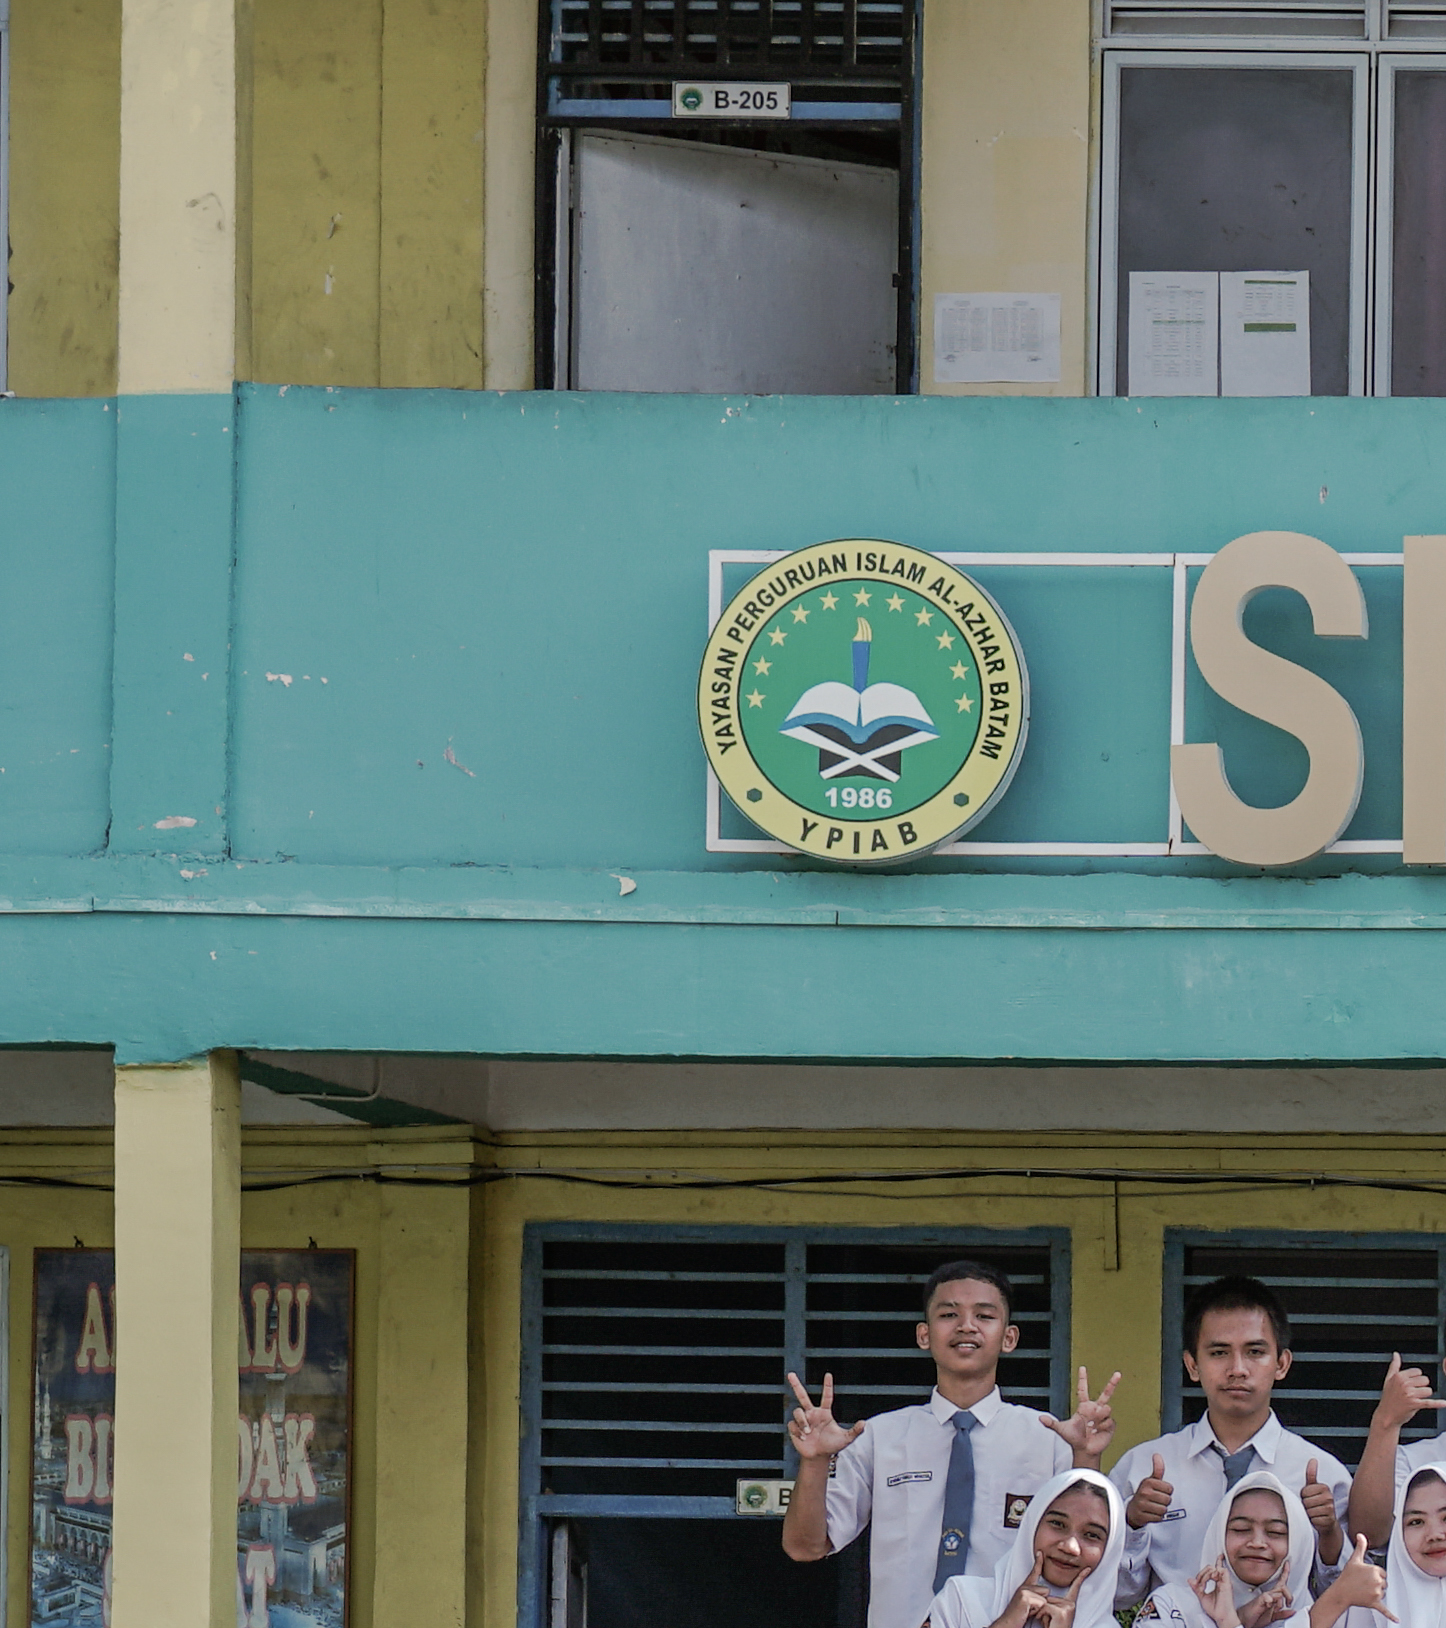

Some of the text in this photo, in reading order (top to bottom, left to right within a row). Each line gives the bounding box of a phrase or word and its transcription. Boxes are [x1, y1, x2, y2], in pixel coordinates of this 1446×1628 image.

[714, 90, 778, 110] B-205
[711, 551, 1010, 761] YAYASAN PERGURUAN ISLAM AL-AZHAR BATAM
[824, 786, 893, 809] 1986
[799, 818, 919, 854] YPIAB
